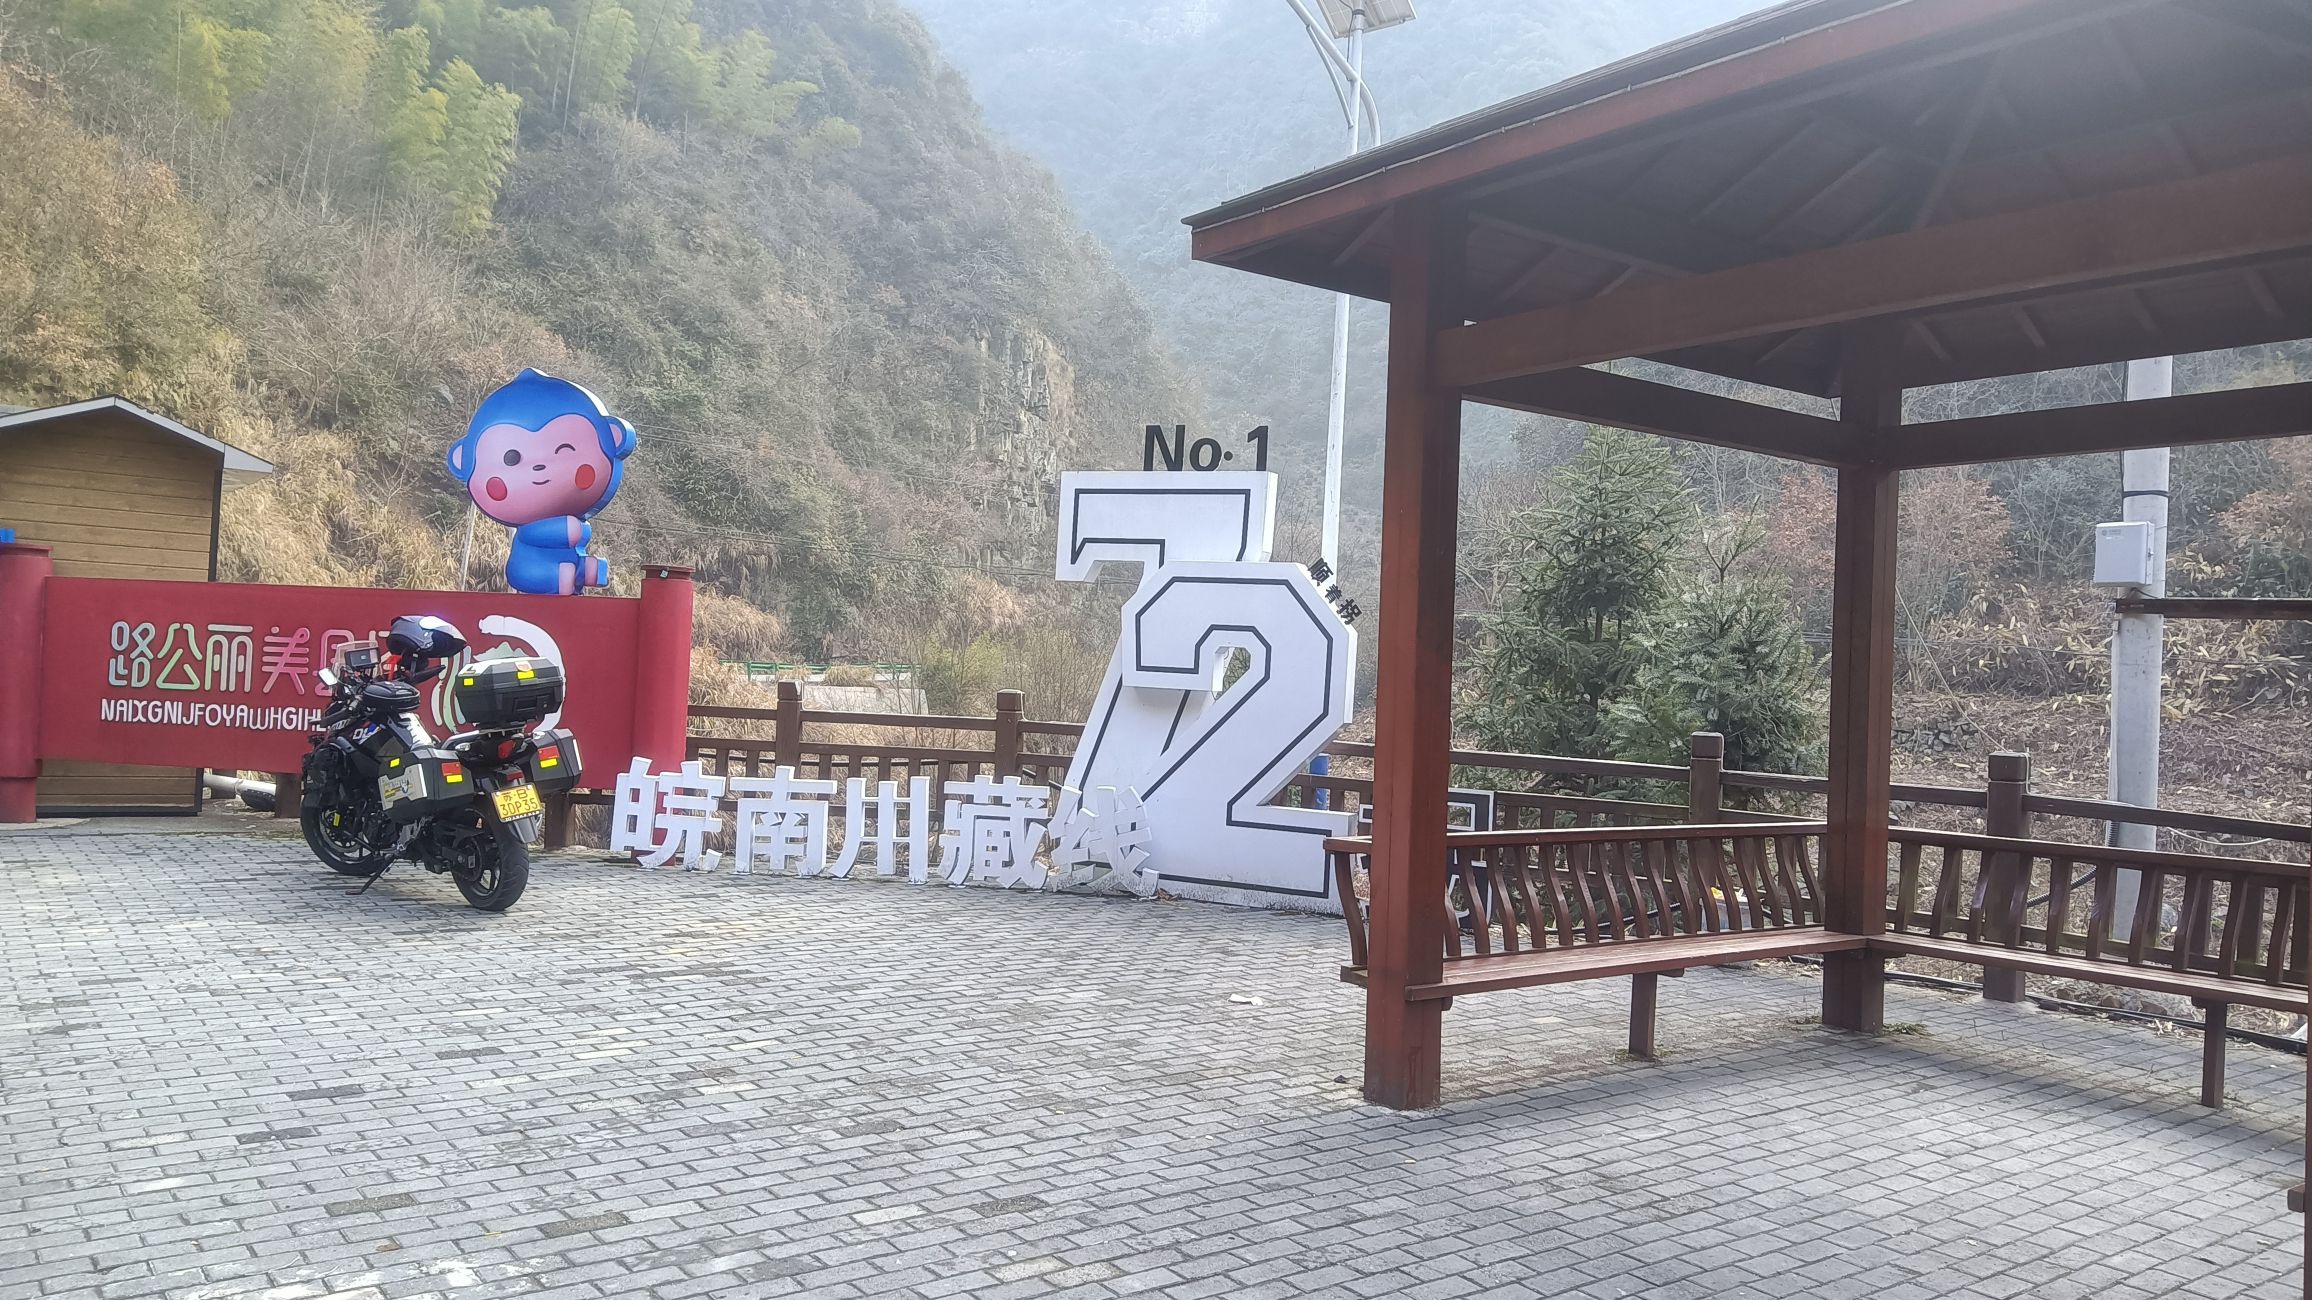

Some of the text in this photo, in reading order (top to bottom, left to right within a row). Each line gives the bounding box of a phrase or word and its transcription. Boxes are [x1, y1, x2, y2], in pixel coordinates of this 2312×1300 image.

[610, 757, 1159, 899] 皖南川藏线
[1055, 471, 1358, 918] 72
